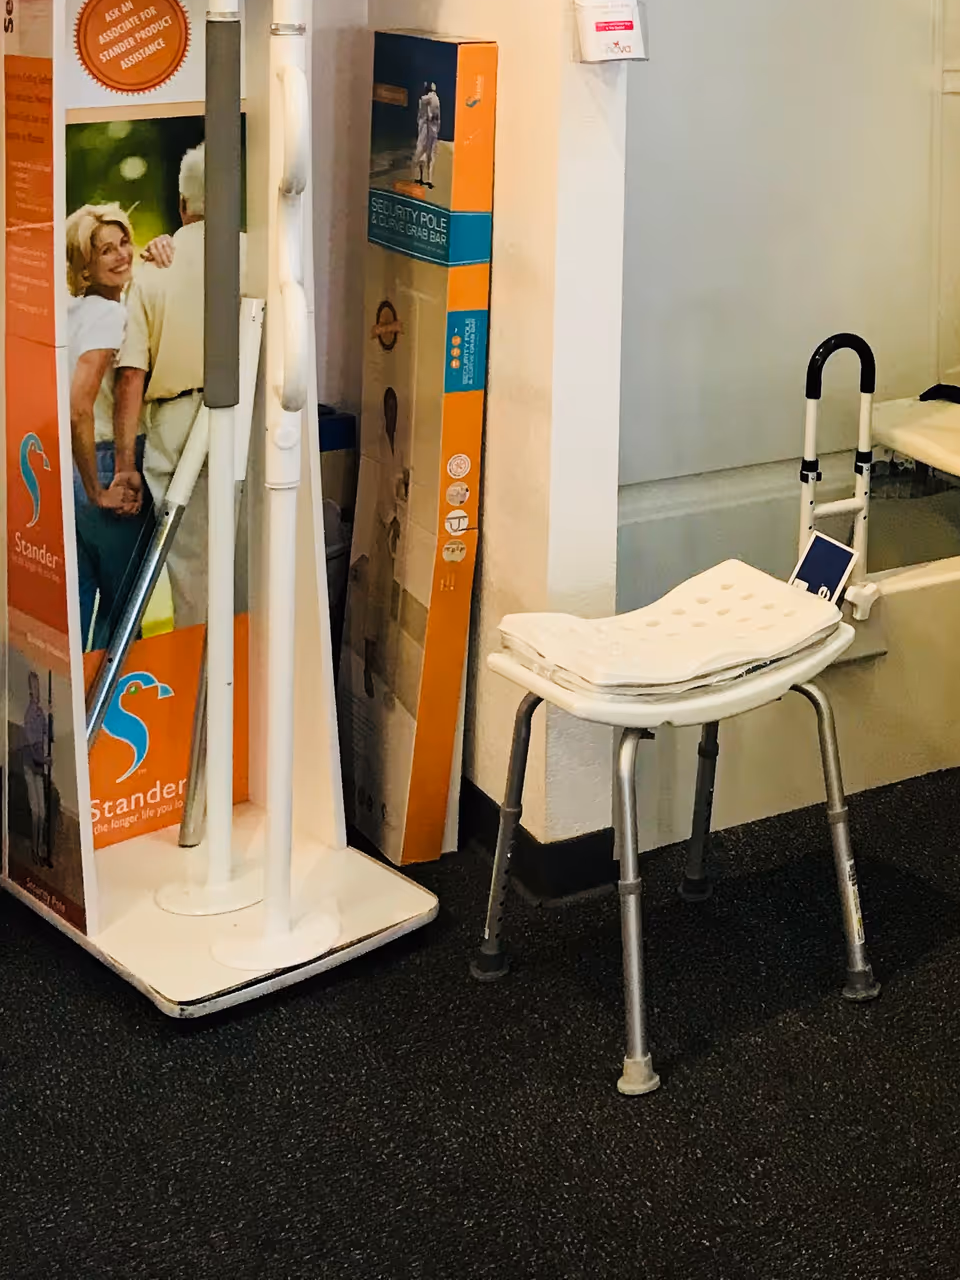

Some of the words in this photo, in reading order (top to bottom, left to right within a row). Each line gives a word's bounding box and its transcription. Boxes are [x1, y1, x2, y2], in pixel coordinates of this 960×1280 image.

[98, 15, 141, 45] ASSOCIATE
[140, 6, 158, 21] FOR
[104, 7, 121, 22] ASK
[120, 0, 134, 14] AN
[99, 37, 137, 63] STANDER
[135, 15, 173, 43] PRODUCT
[120, 38, 166, 70] ASSISTANCE
[370, 196, 419, 224] SECURITY
[420, 211, 448, 234] POLE
[371, 213, 377, 225] &
[378, 214, 405, 234] CURVE
[405, 224, 429, 241] GRAB
[429, 229, 448, 246] BAR
[15, 531, 59, 568] Stander
[90, 778, 187, 822] Stander
[111, 813, 139, 830] longer
[141, 807, 156, 820] life
[156, 803, 173, 818] you
